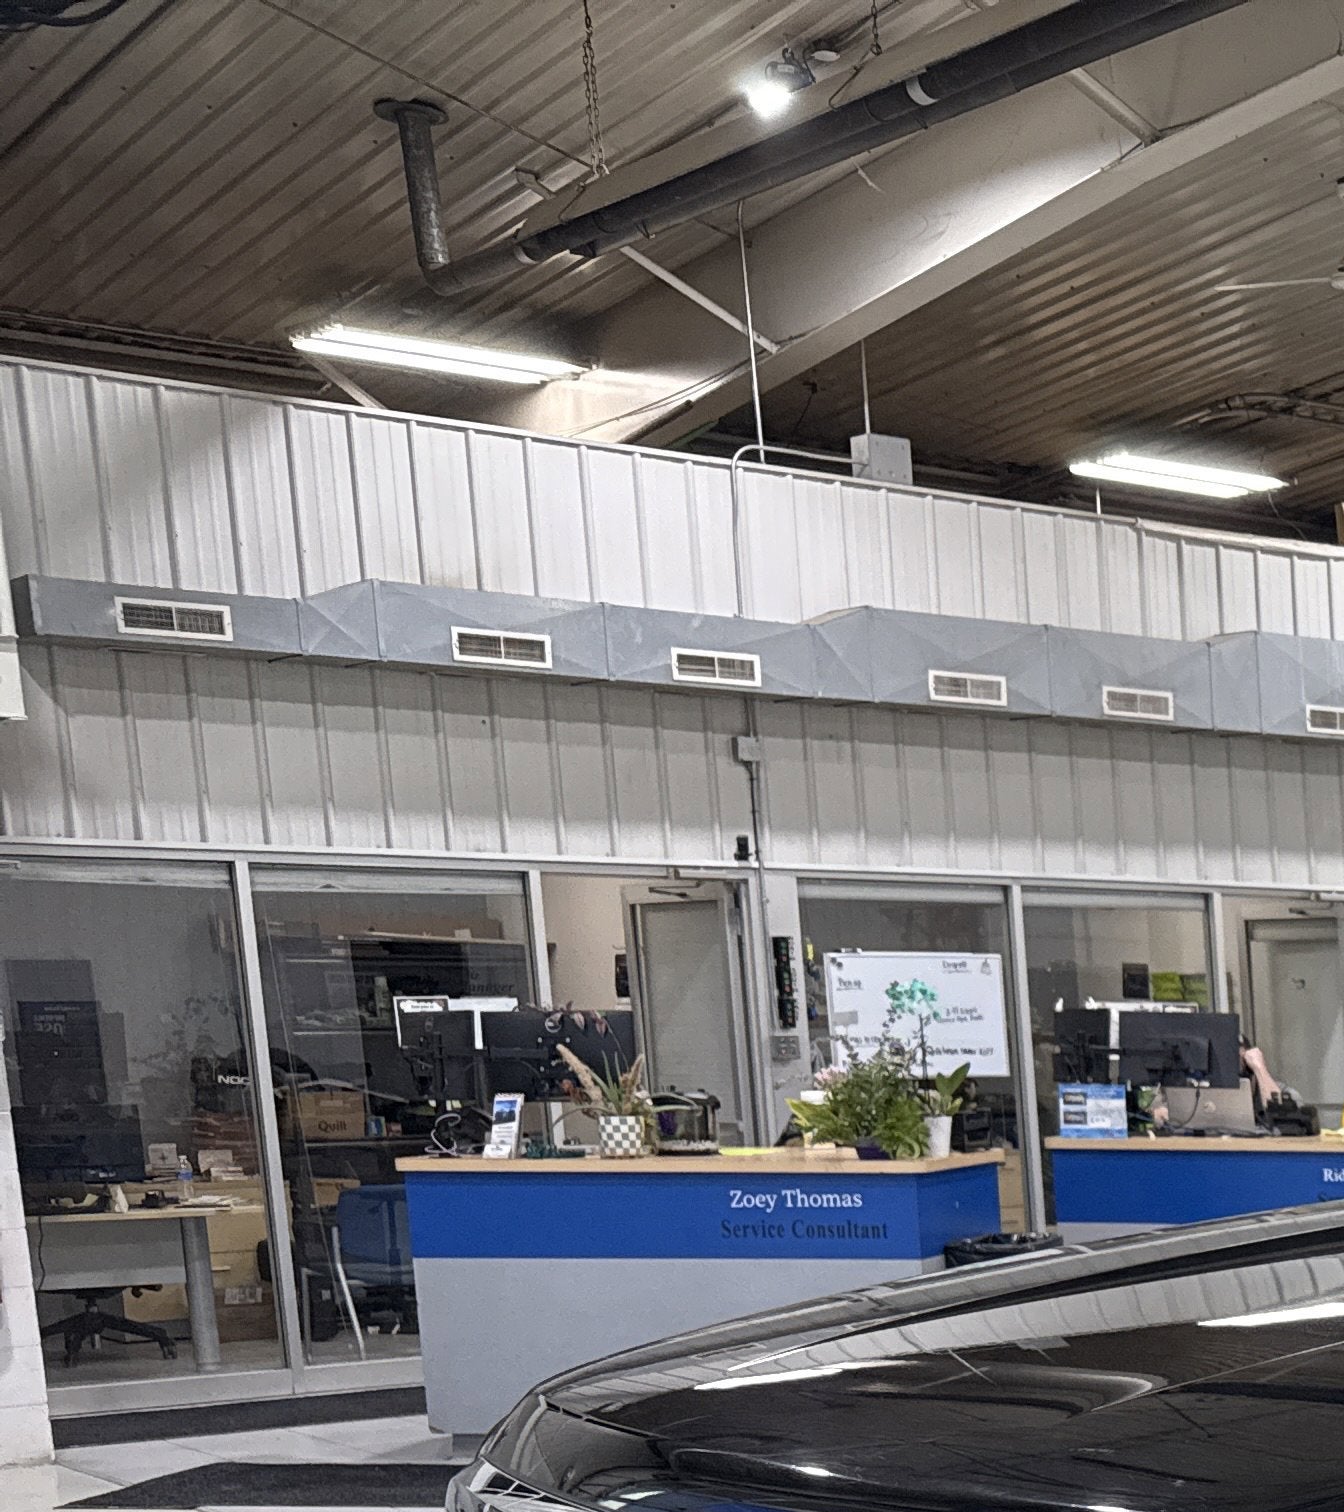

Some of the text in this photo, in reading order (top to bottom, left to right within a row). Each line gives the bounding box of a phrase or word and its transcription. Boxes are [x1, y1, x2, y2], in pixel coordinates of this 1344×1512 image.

[729, 1188, 863, 1213] Zoey Thomas
[720, 1218, 889, 1240] Service Consultant
